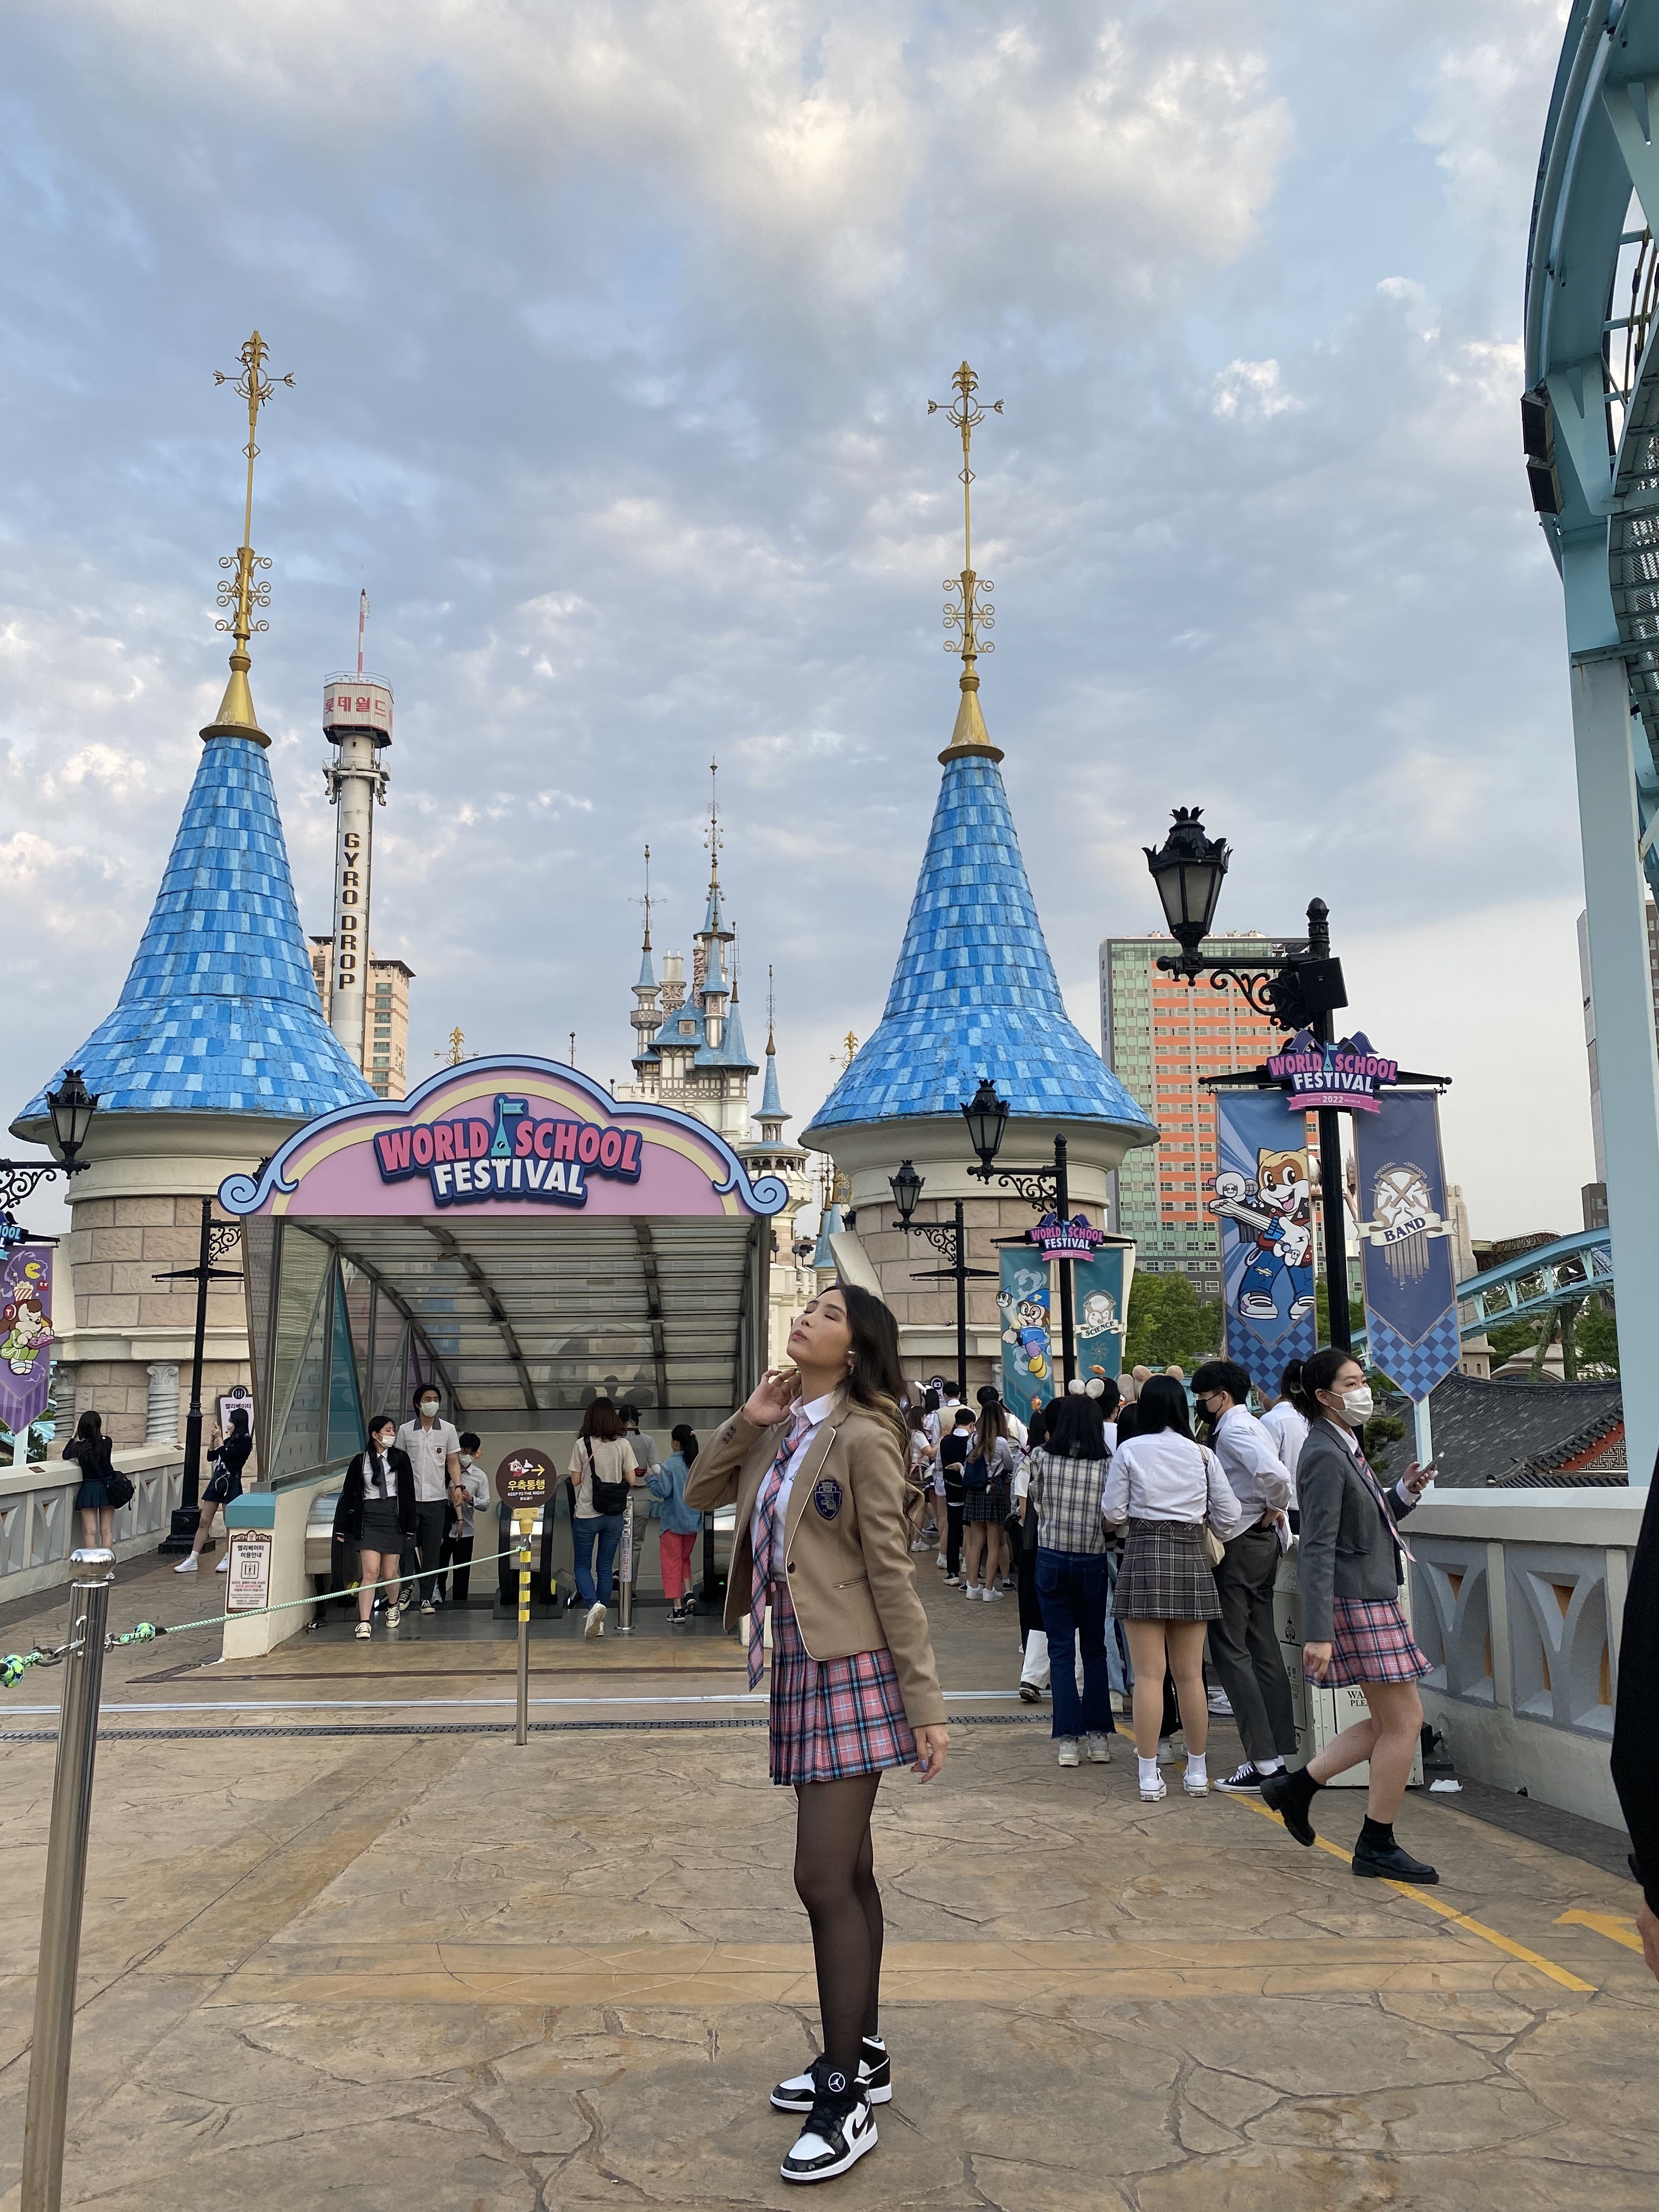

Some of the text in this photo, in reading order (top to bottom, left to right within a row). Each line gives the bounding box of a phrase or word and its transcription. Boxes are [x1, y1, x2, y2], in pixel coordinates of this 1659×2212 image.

[325, 696, 386, 717] 롯데월드
[339, 833, 360, 990] GYRO DROP
[1269, 1053, 1396, 1081] WORLD SCHOOL
[1293, 1072, 1374, 1093] FESTIVAL
[1323, 1096, 1344, 1104] 2022
[378, 1120, 639, 1171] WORLD SCHOOL
[433, 1158, 583, 1195] FESTIVAL
[0, 1225, 21, 1239] OOL
[1031, 1226, 1104, 1243] WORLD SCHOOL
[1383, 1217, 1426, 1242] BAND
[1044, 1238, 1090, 1250] FESTIVAL
[1085, 1321, 1115, 1336] SCIENCE
[507, 1479, 545, 1491] 우측통행
[1347, 1690, 1364, 1699] WA
